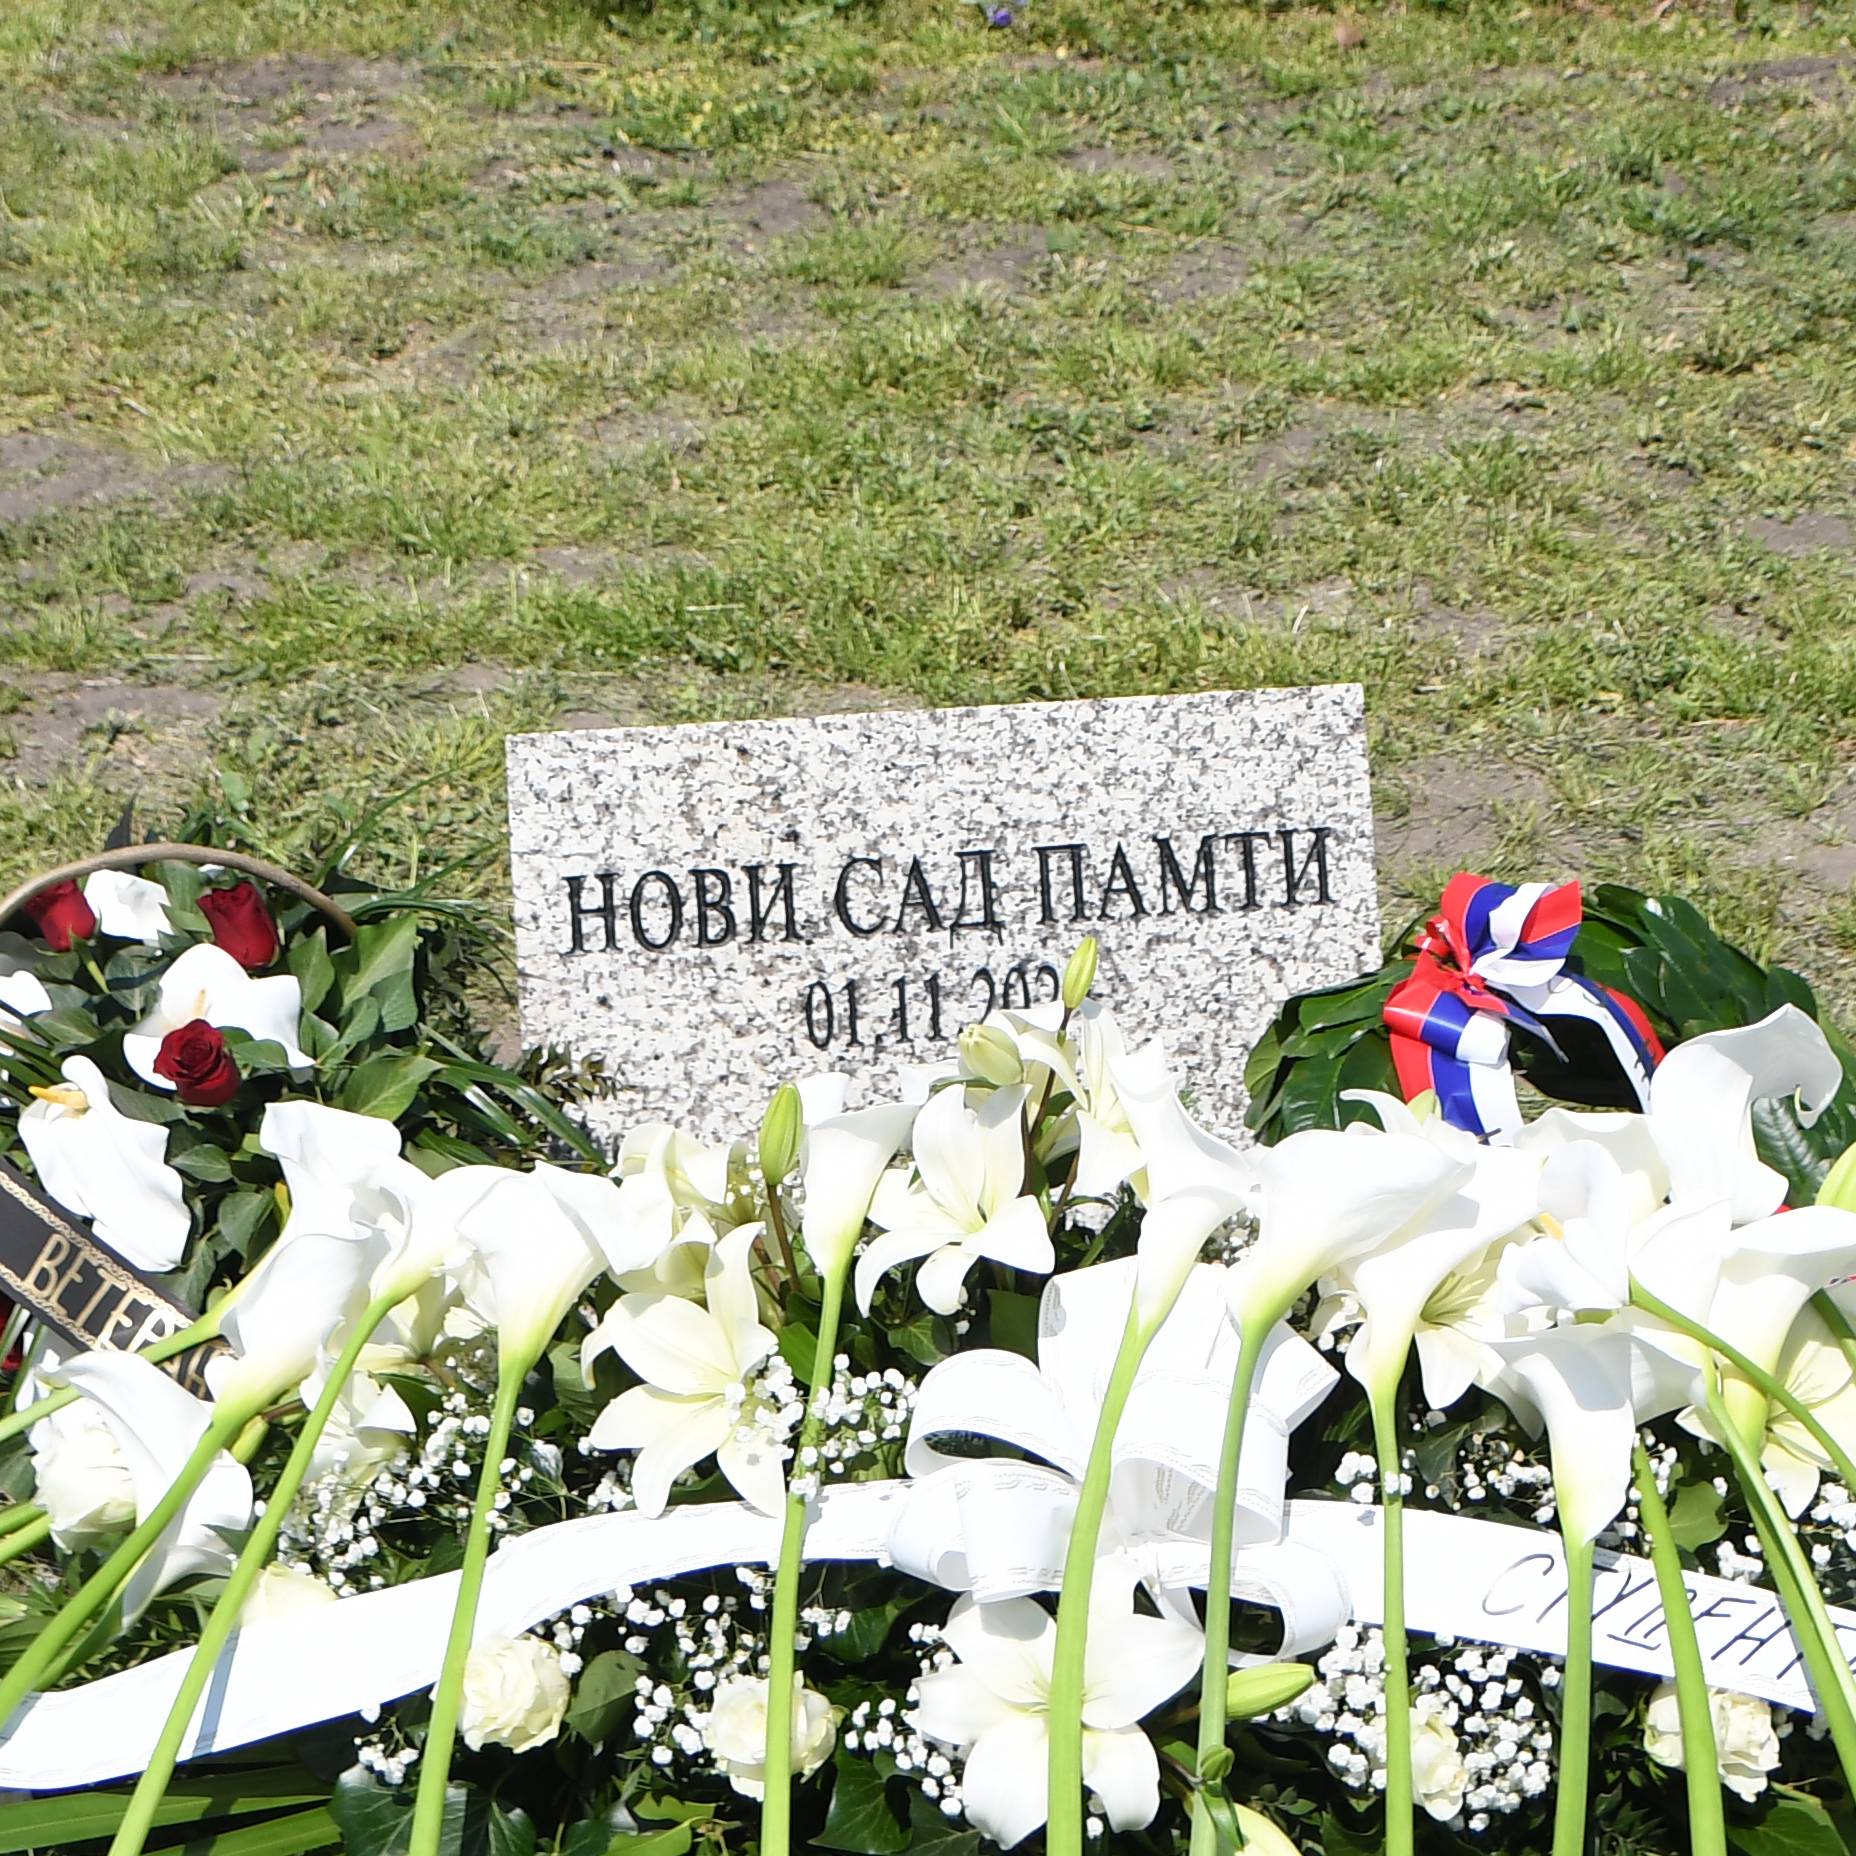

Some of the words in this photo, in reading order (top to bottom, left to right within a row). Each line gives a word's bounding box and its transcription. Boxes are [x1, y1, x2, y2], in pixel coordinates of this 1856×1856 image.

[562, 863, 804, 957] НОВИ
[834, 848, 1006, 946] САД
[1034, 827, 1336, 927] ПАМТИ
